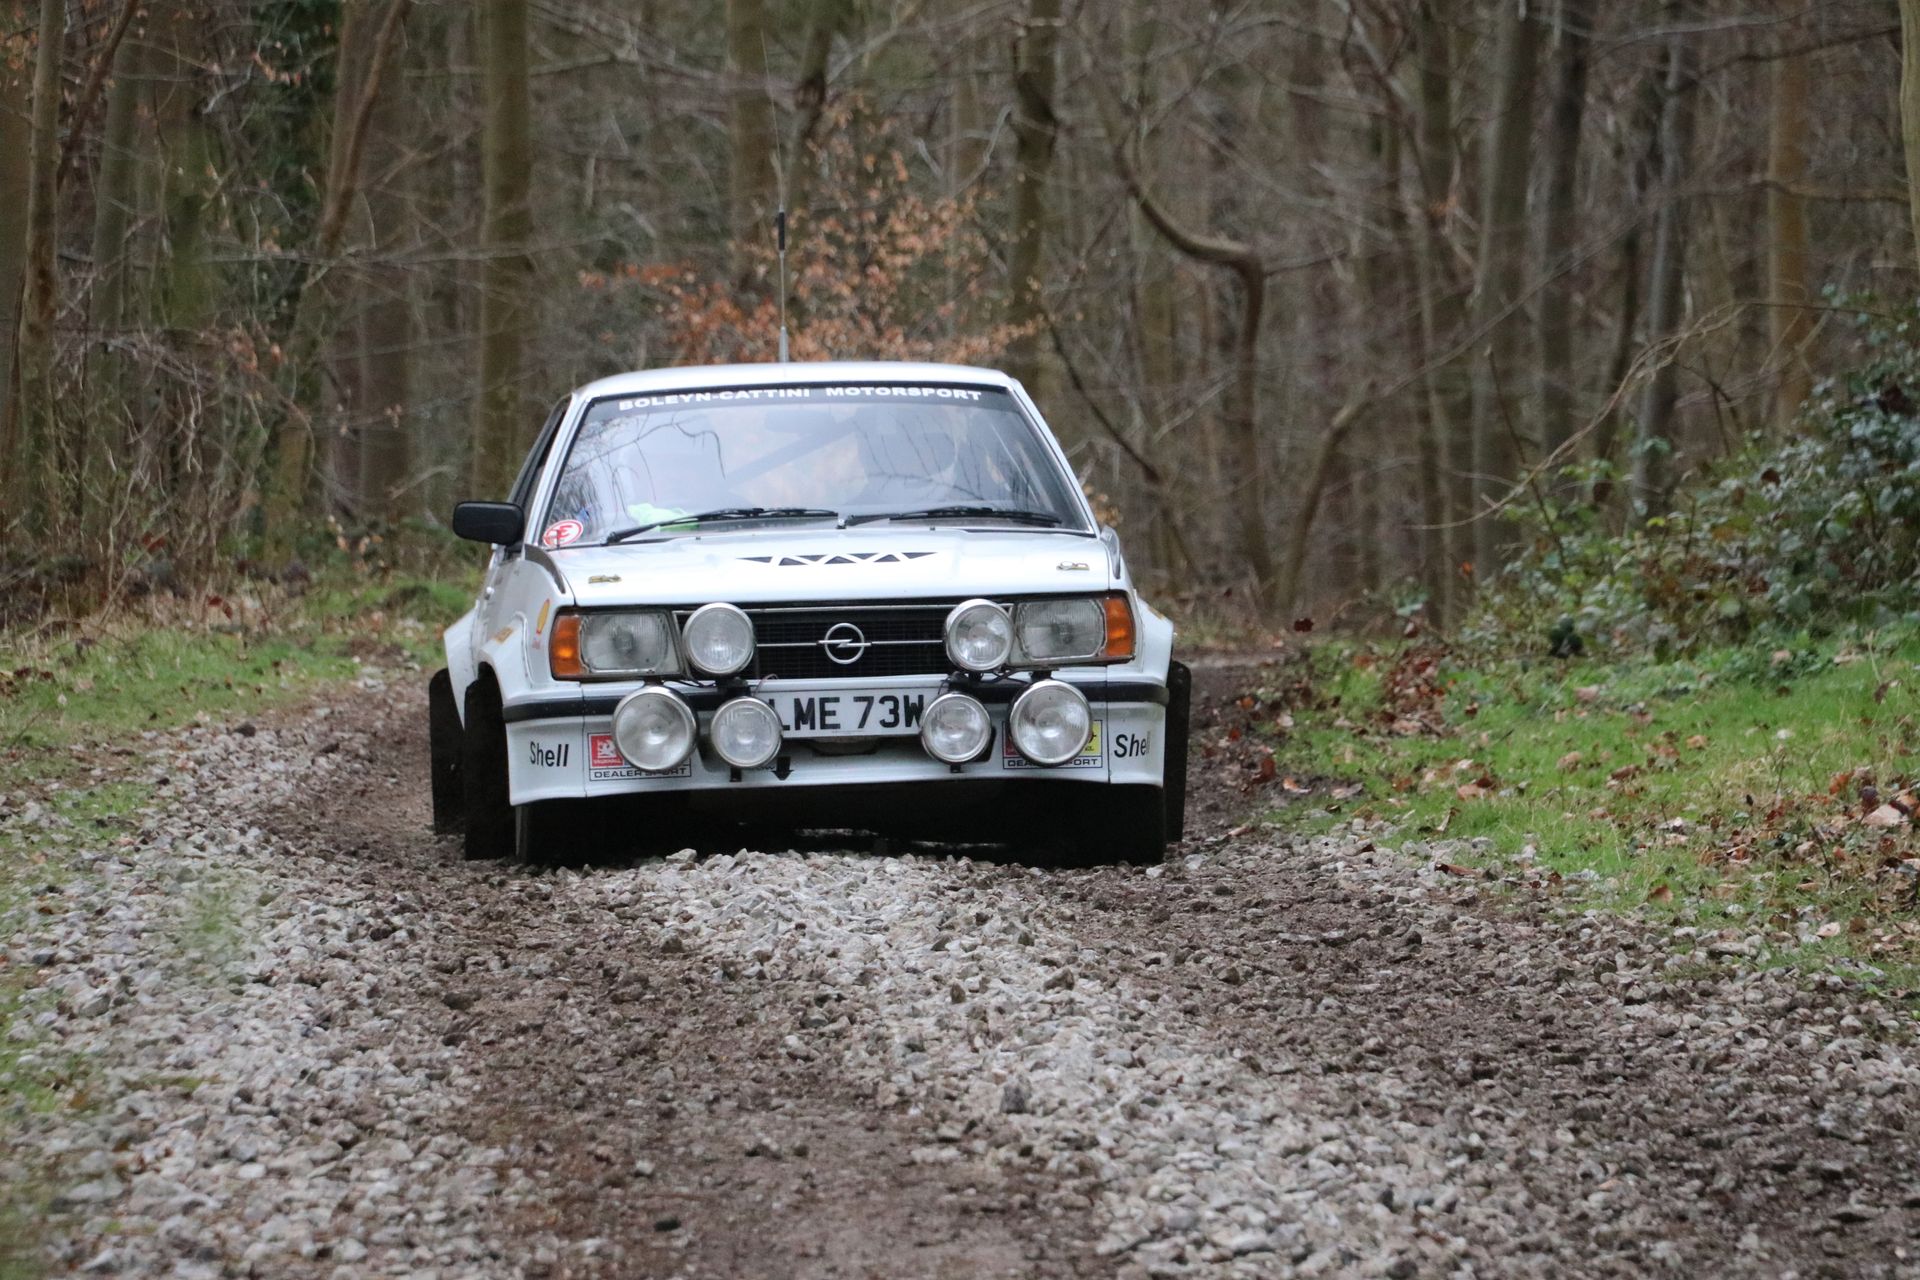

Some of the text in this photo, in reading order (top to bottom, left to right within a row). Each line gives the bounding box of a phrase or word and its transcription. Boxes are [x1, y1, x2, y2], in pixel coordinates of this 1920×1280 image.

[618, 387, 982, 411] BOLEYN-CATTINI MOTORSPORT
[853, 694, 924, 729] 73W
[529, 741, 569, 767] Shell
[594, 769, 642, 778] DEALER
